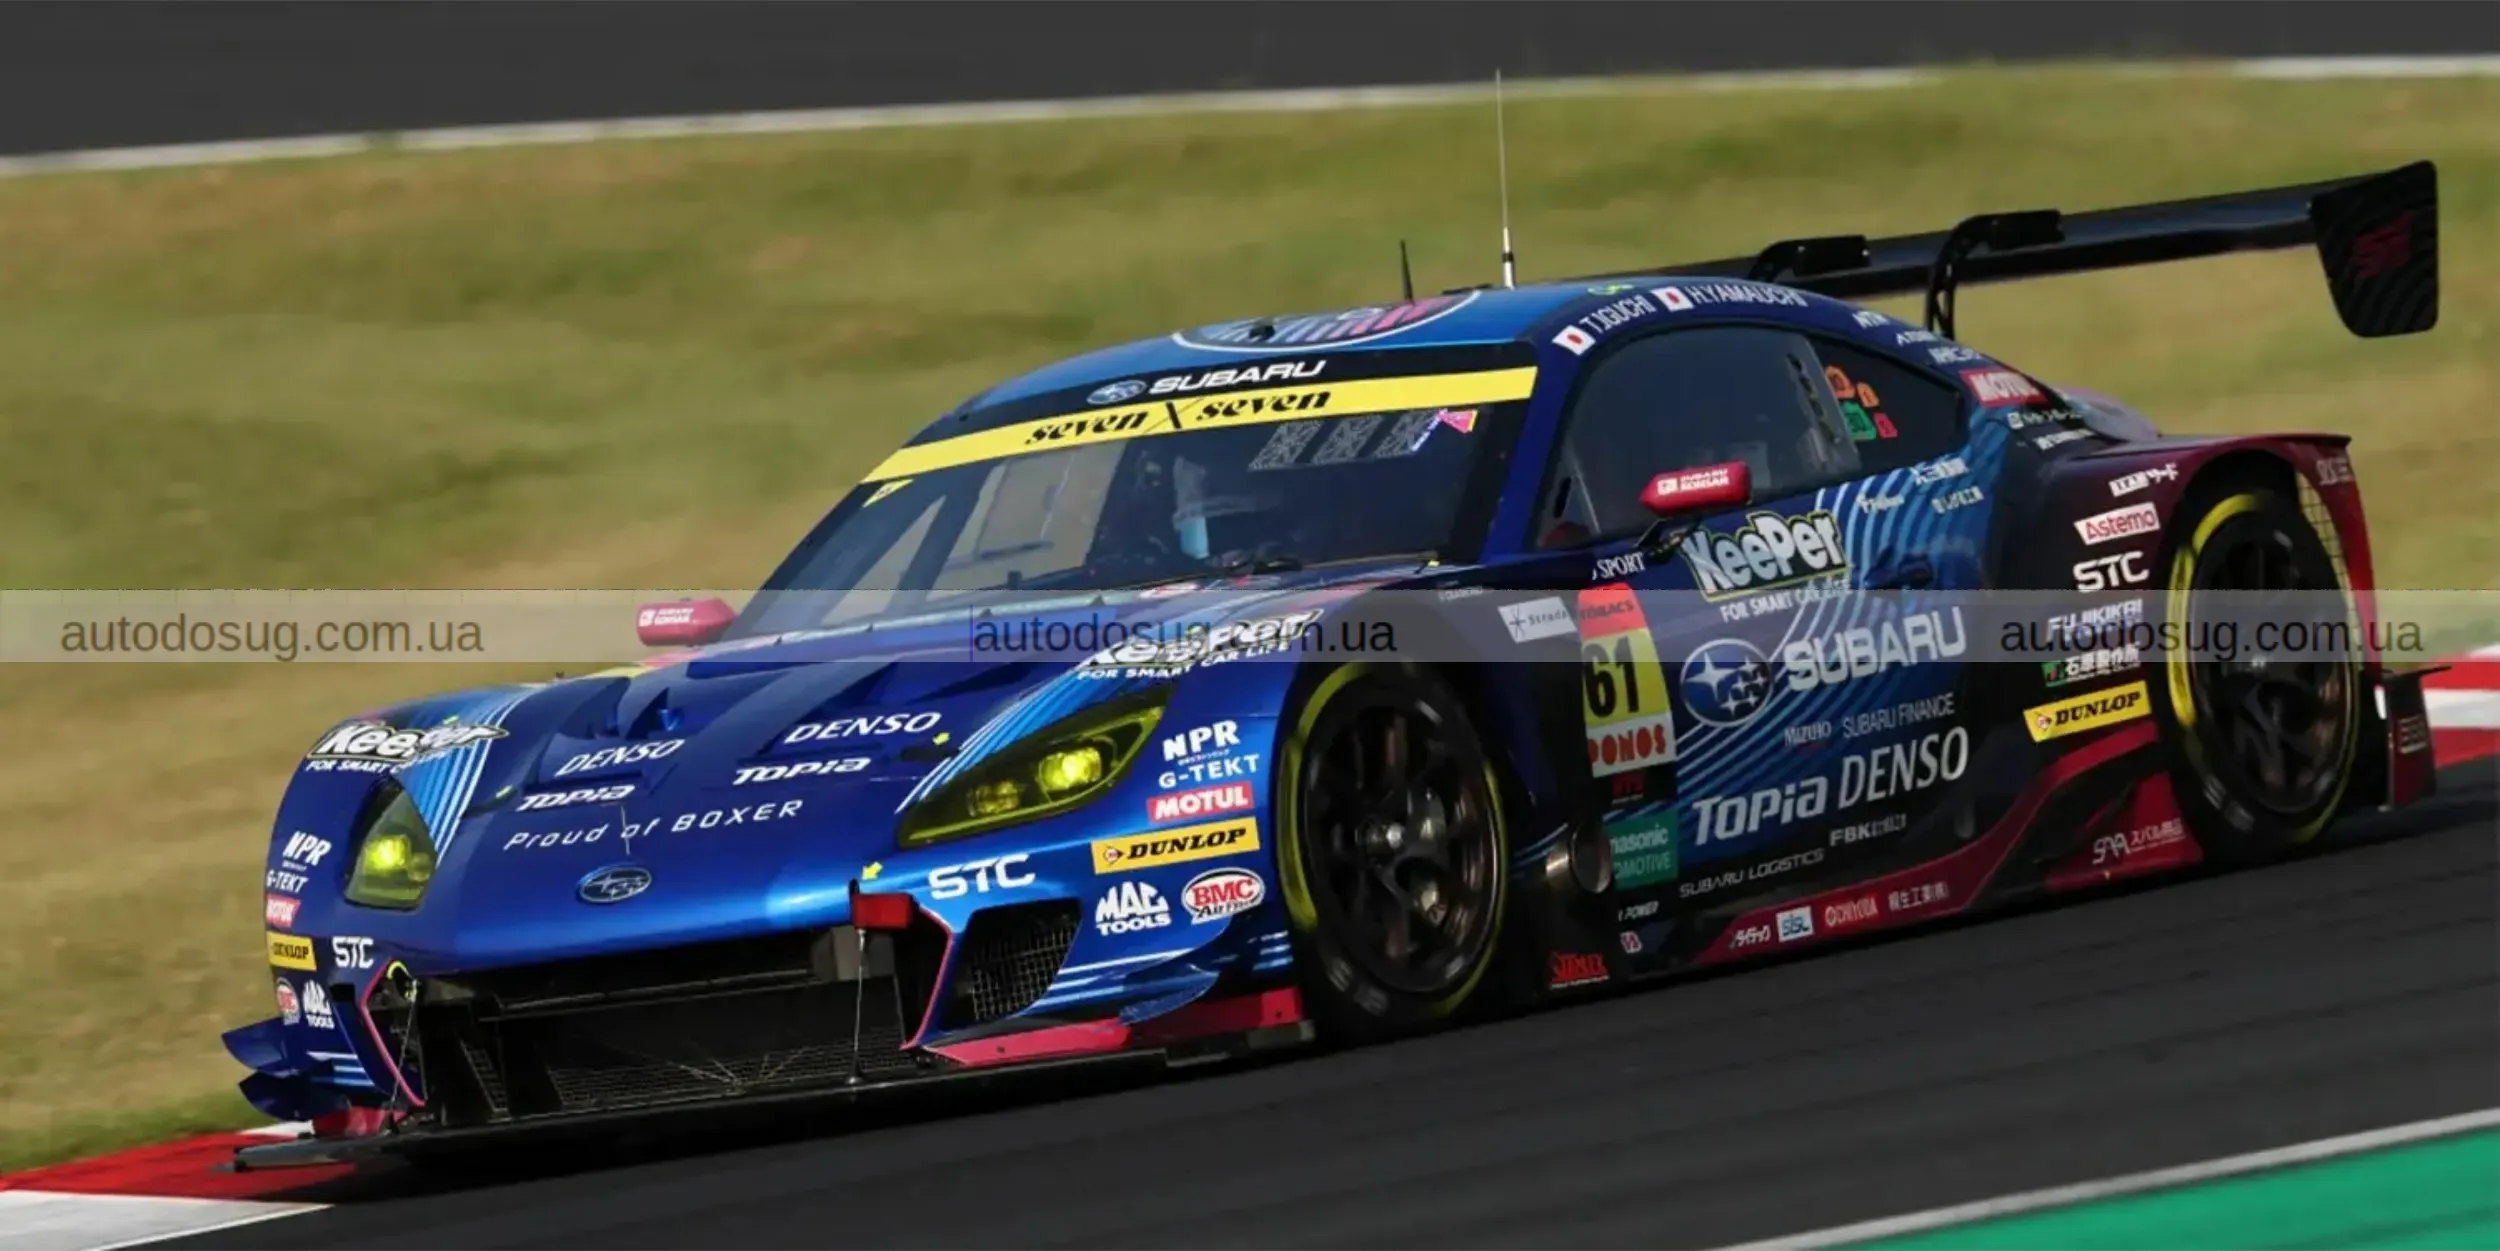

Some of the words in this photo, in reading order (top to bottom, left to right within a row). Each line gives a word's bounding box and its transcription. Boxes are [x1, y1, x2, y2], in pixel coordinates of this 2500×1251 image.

[1148, 360, 1327, 394] SUBARU
[1025, 410, 1148, 445] seven
[1196, 390, 1331, 421] seven
[2085, 510, 2156, 540] Astemo
[1597, 552, 1645, 580] SPORT
[1681, 515, 1844, 594] KeePer
[2072, 551, 2150, 593] STC
[1720, 601, 1748, 623] FOR
[1752, 591, 1793, 615] SMART
[1077, 667, 1116, 680] FOR
[1125, 663, 1191, 679] SMART
[1200, 651, 1240, 668] CAR
[1783, 606, 1967, 691] SUBARU
[1582, 636, 1638, 718] 61
[1843, 706, 1895, 738] SUBARU
[1898, 693, 1955, 721] FINANCE
[2055, 692, 2140, 725] DUNLOP
[784, 713, 941, 743] DENSO
[1162, 720, 1240, 761] NPR
[554, 739, 684, 777] DENSO
[1158, 754, 1260, 788] G-TEKT
[1838, 726, 1968, 809] DENSO
[1154, 786, 1248, 819] MOTUL
[504, 824, 609, 851] Proud
[622, 818, 660, 838] of
[672, 800, 802, 832] BOXER
[1829, 821, 1871, 846] FBK
[283, 831, 332, 866] NPR
[1127, 828, 1247, 859] DUNLOP
[928, 854, 1036, 900] STC
[1679, 871, 1744, 898] SUBARU
[1749, 848, 1824, 879] LOGISTICS
[1096, 882, 1170, 924] MAC
[1192, 879, 1255, 905] BMC
[1097, 912, 1171, 936] TOOLS
[332, 936, 373, 969] STC
